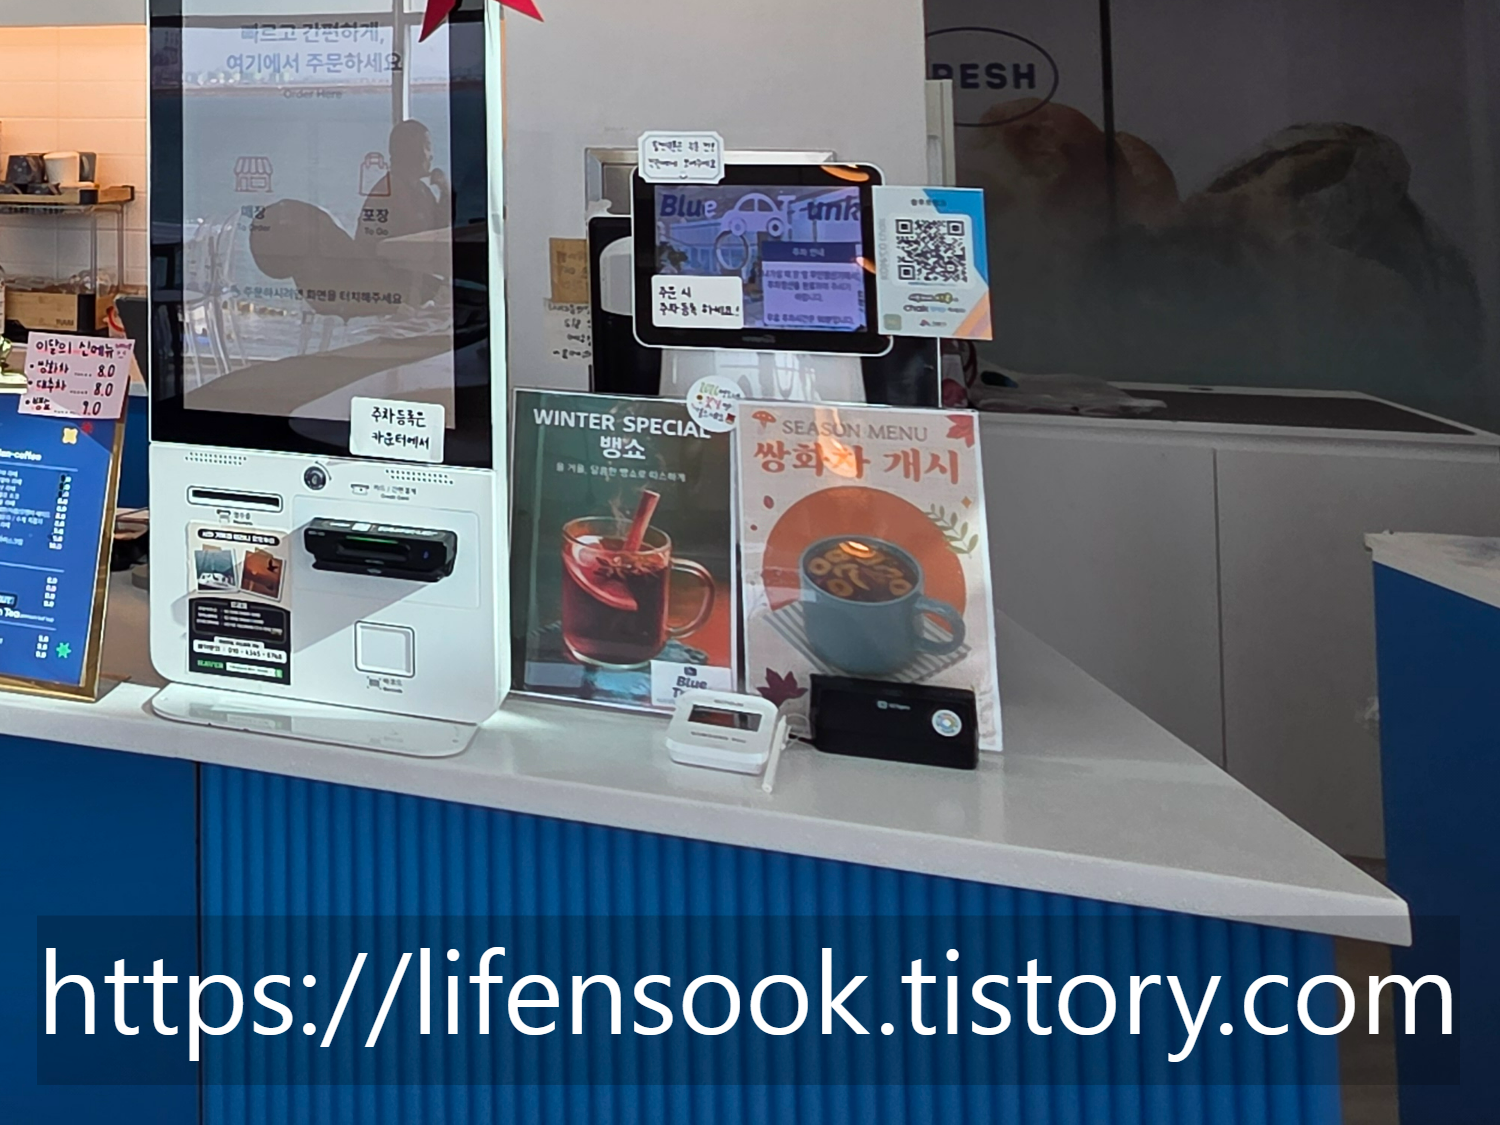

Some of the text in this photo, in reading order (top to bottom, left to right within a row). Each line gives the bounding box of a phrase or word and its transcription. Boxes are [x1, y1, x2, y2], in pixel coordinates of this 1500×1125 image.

[240, 20, 385, 45] 빠르고 간편하게,
[226, 51, 403, 74] 여기에서 주문하세요
[283, 88, 343, 100] Order Here
[362, 207, 389, 223] 포장
[659, 194, 718, 218] Blue
[364, 226, 375, 236] To
[658, 286, 691, 300] 주문 시
[36, 338, 72, 356] 이달의
[97, 363, 116, 378] 8.0
[93, 382, 114, 397] 8.0
[533, 408, 712, 439] WINTER SPECIAL
[781, 419, 929, 442] SEASON MENU
[371, 430, 430, 450] 카운터에서
[600, 435, 646, 460] 뱅쇼
[754, 440, 960, 485] 쌍화차 개시
[676, 676, 708, 690] Blue
